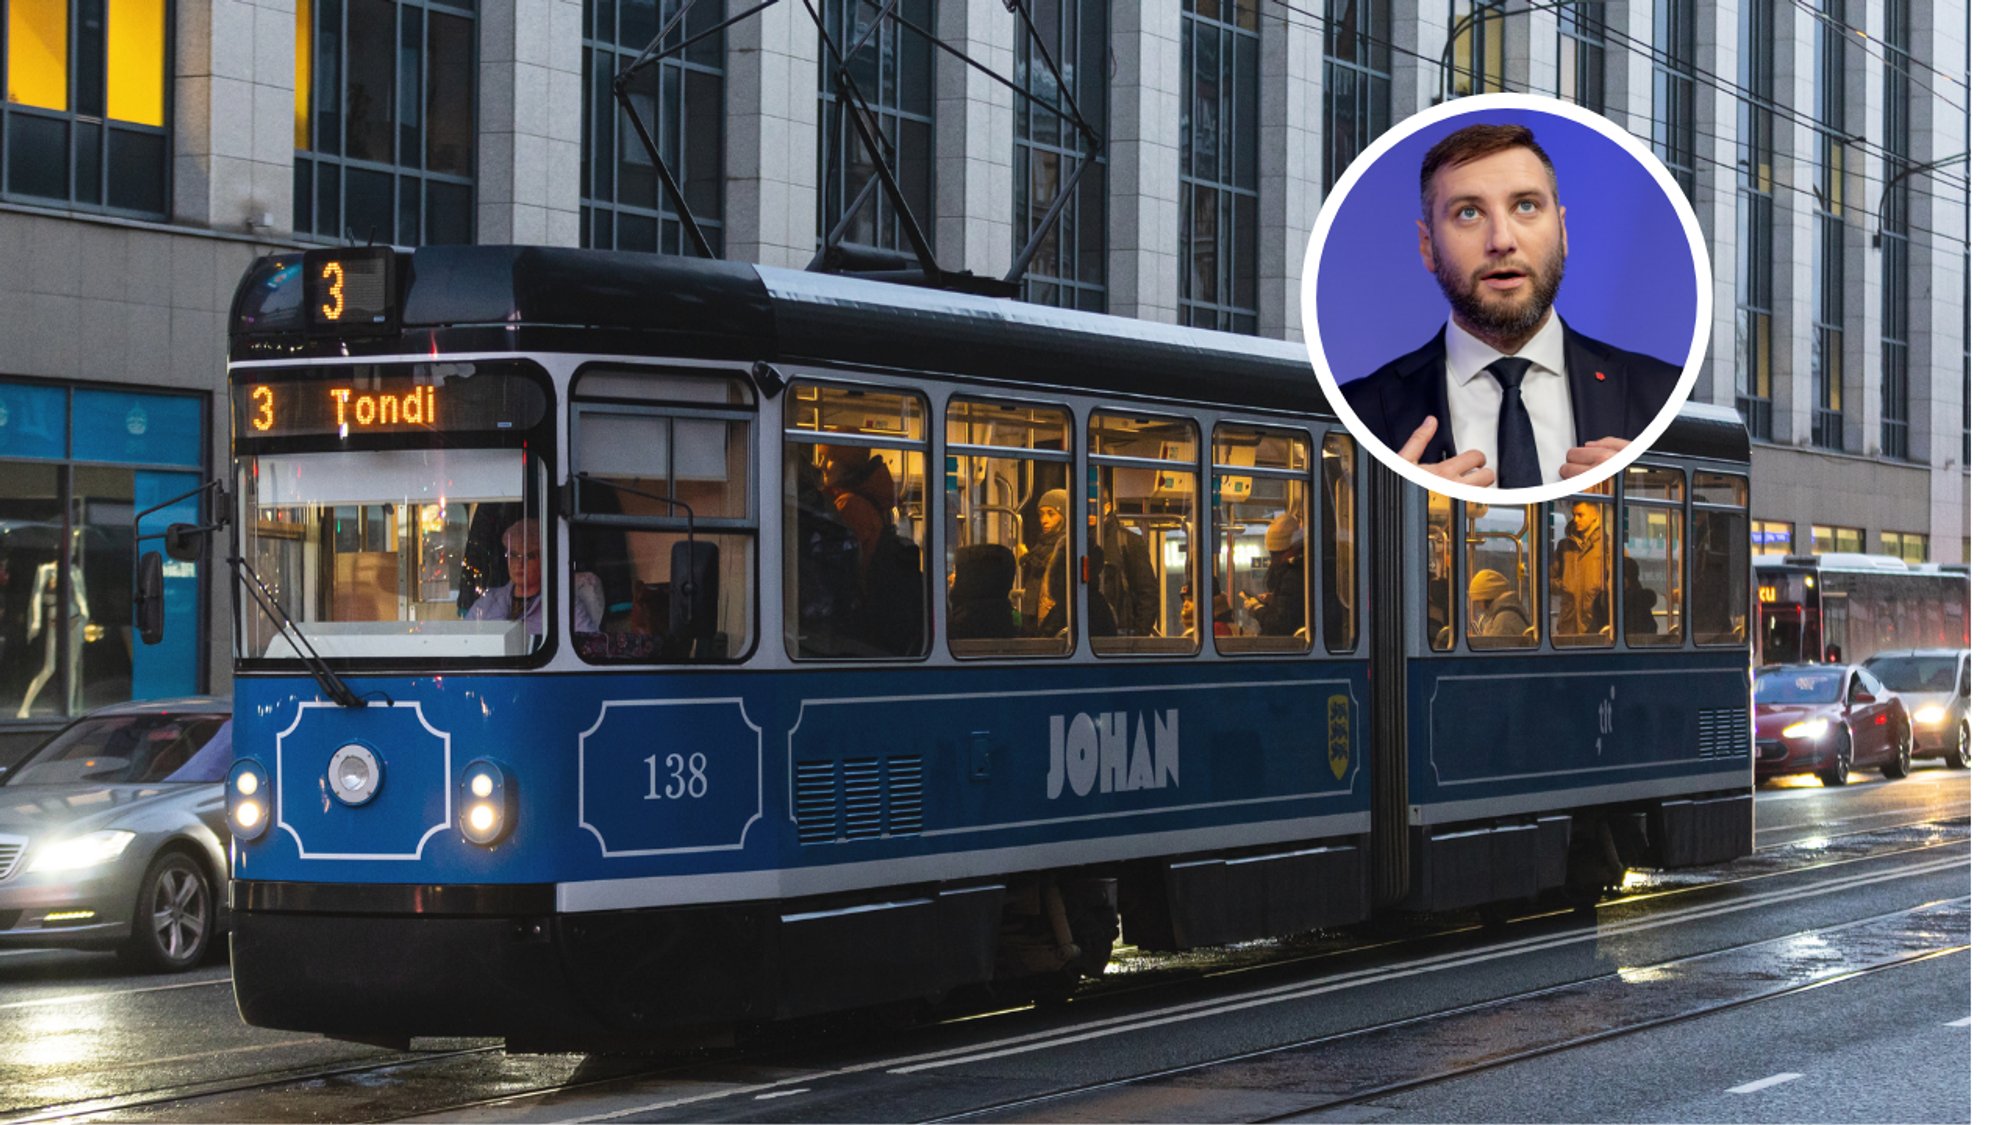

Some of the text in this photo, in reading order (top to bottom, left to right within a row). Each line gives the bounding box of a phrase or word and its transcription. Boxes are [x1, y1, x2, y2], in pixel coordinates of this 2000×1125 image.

[321, 261, 345, 321] 3
[252, 385, 436, 432] 3 Tondi
[643, 752, 708, 800] 138
[1047, 709, 1179, 799] JOHAN
